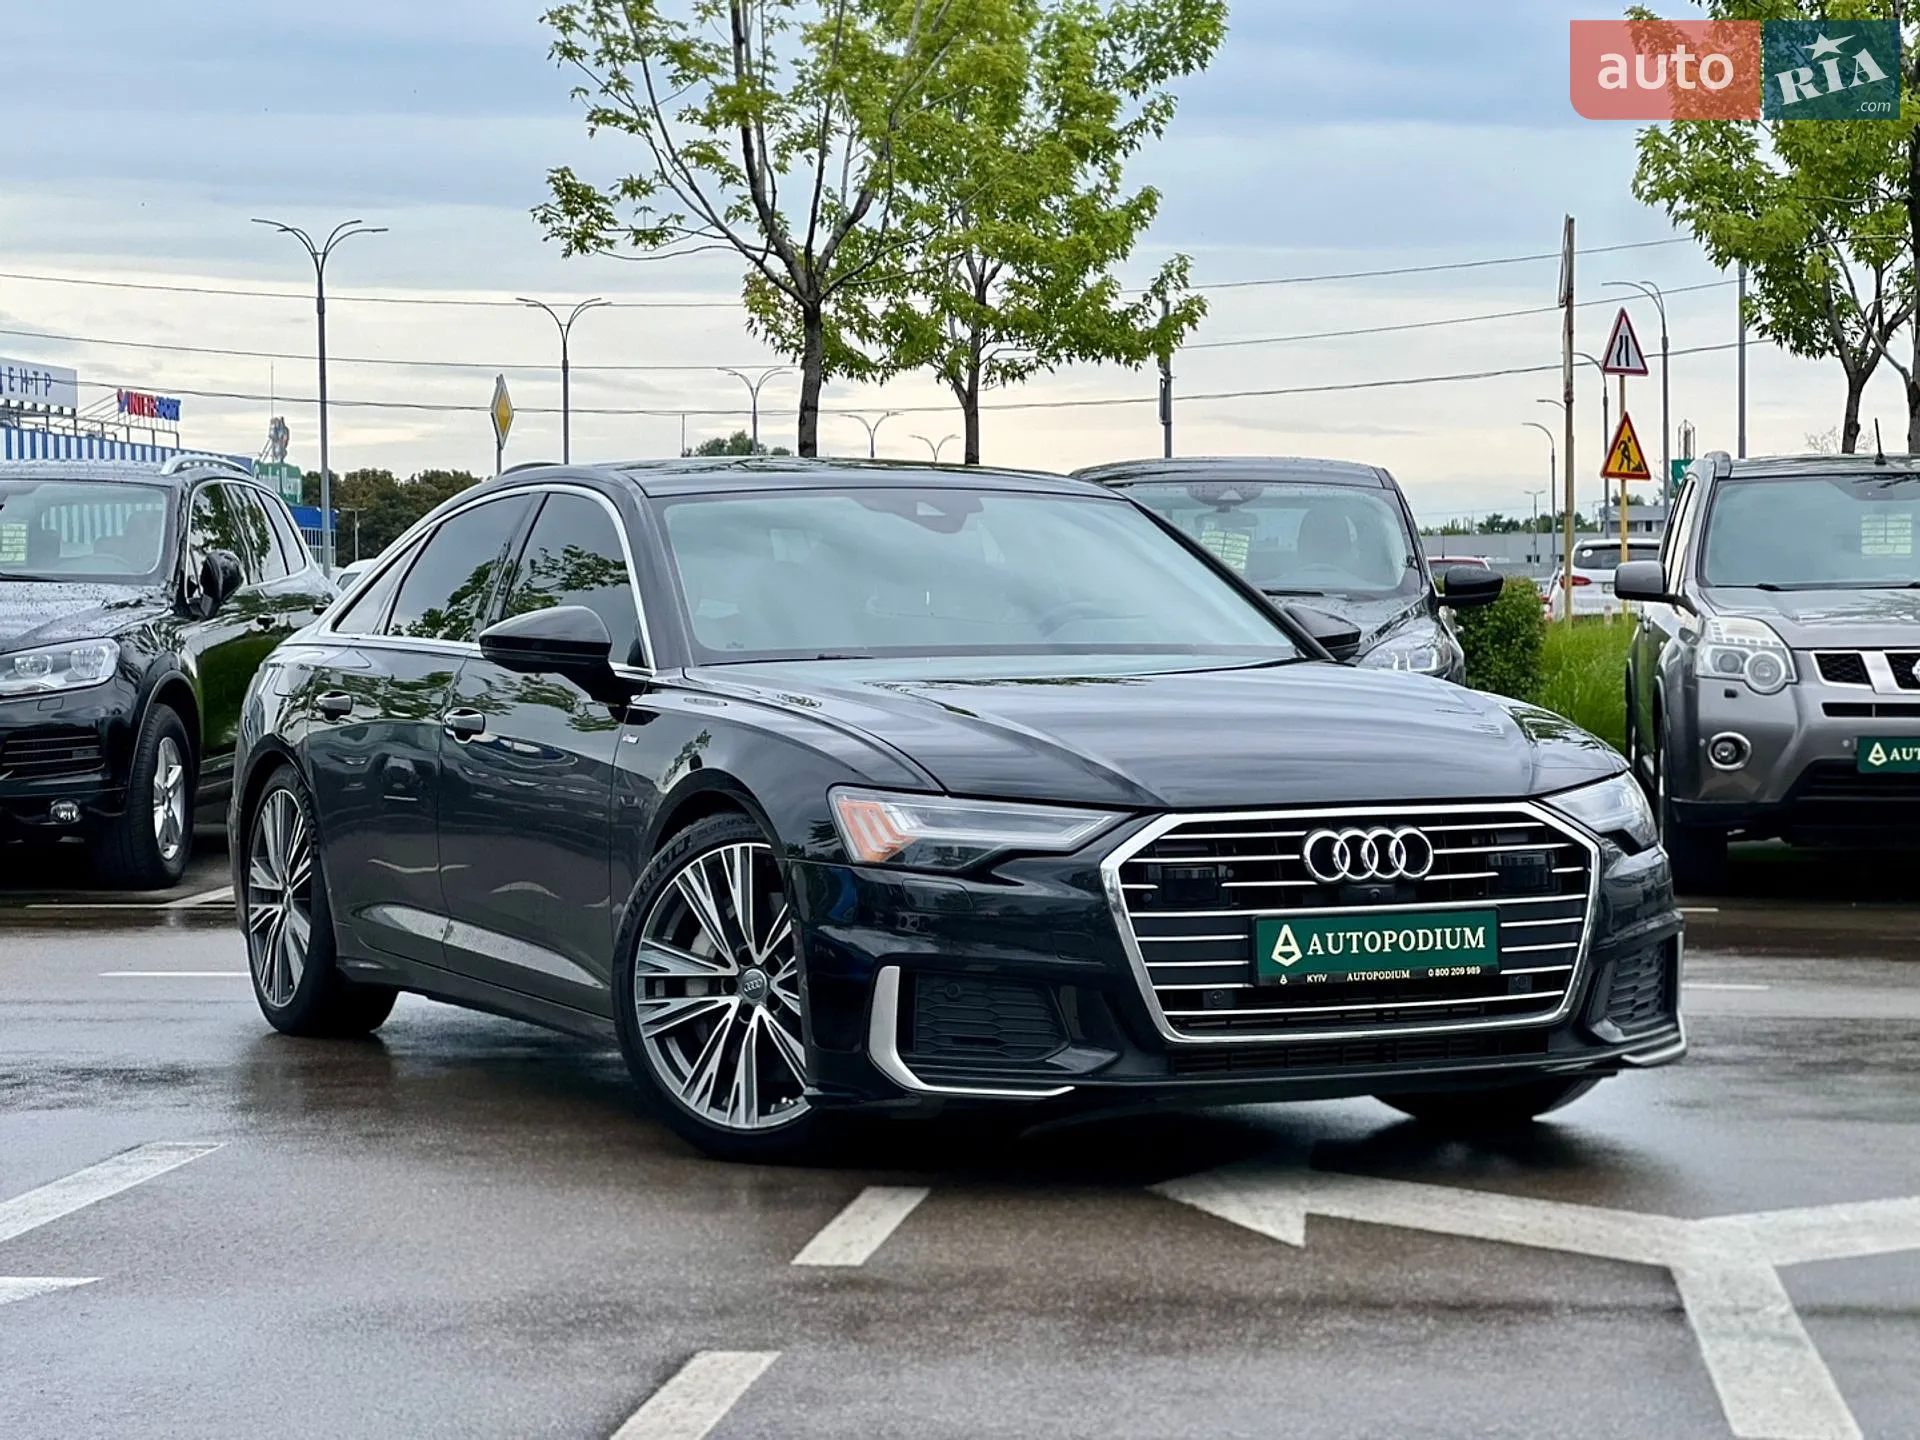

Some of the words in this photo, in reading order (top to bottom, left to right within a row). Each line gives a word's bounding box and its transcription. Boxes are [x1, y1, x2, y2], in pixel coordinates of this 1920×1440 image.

[1307, 926, 1486, 956] AUTOPODIUM
[1306, 974, 1328, 983] KYIV
[1346, 970, 1410, 982] AUTOPODIUM
